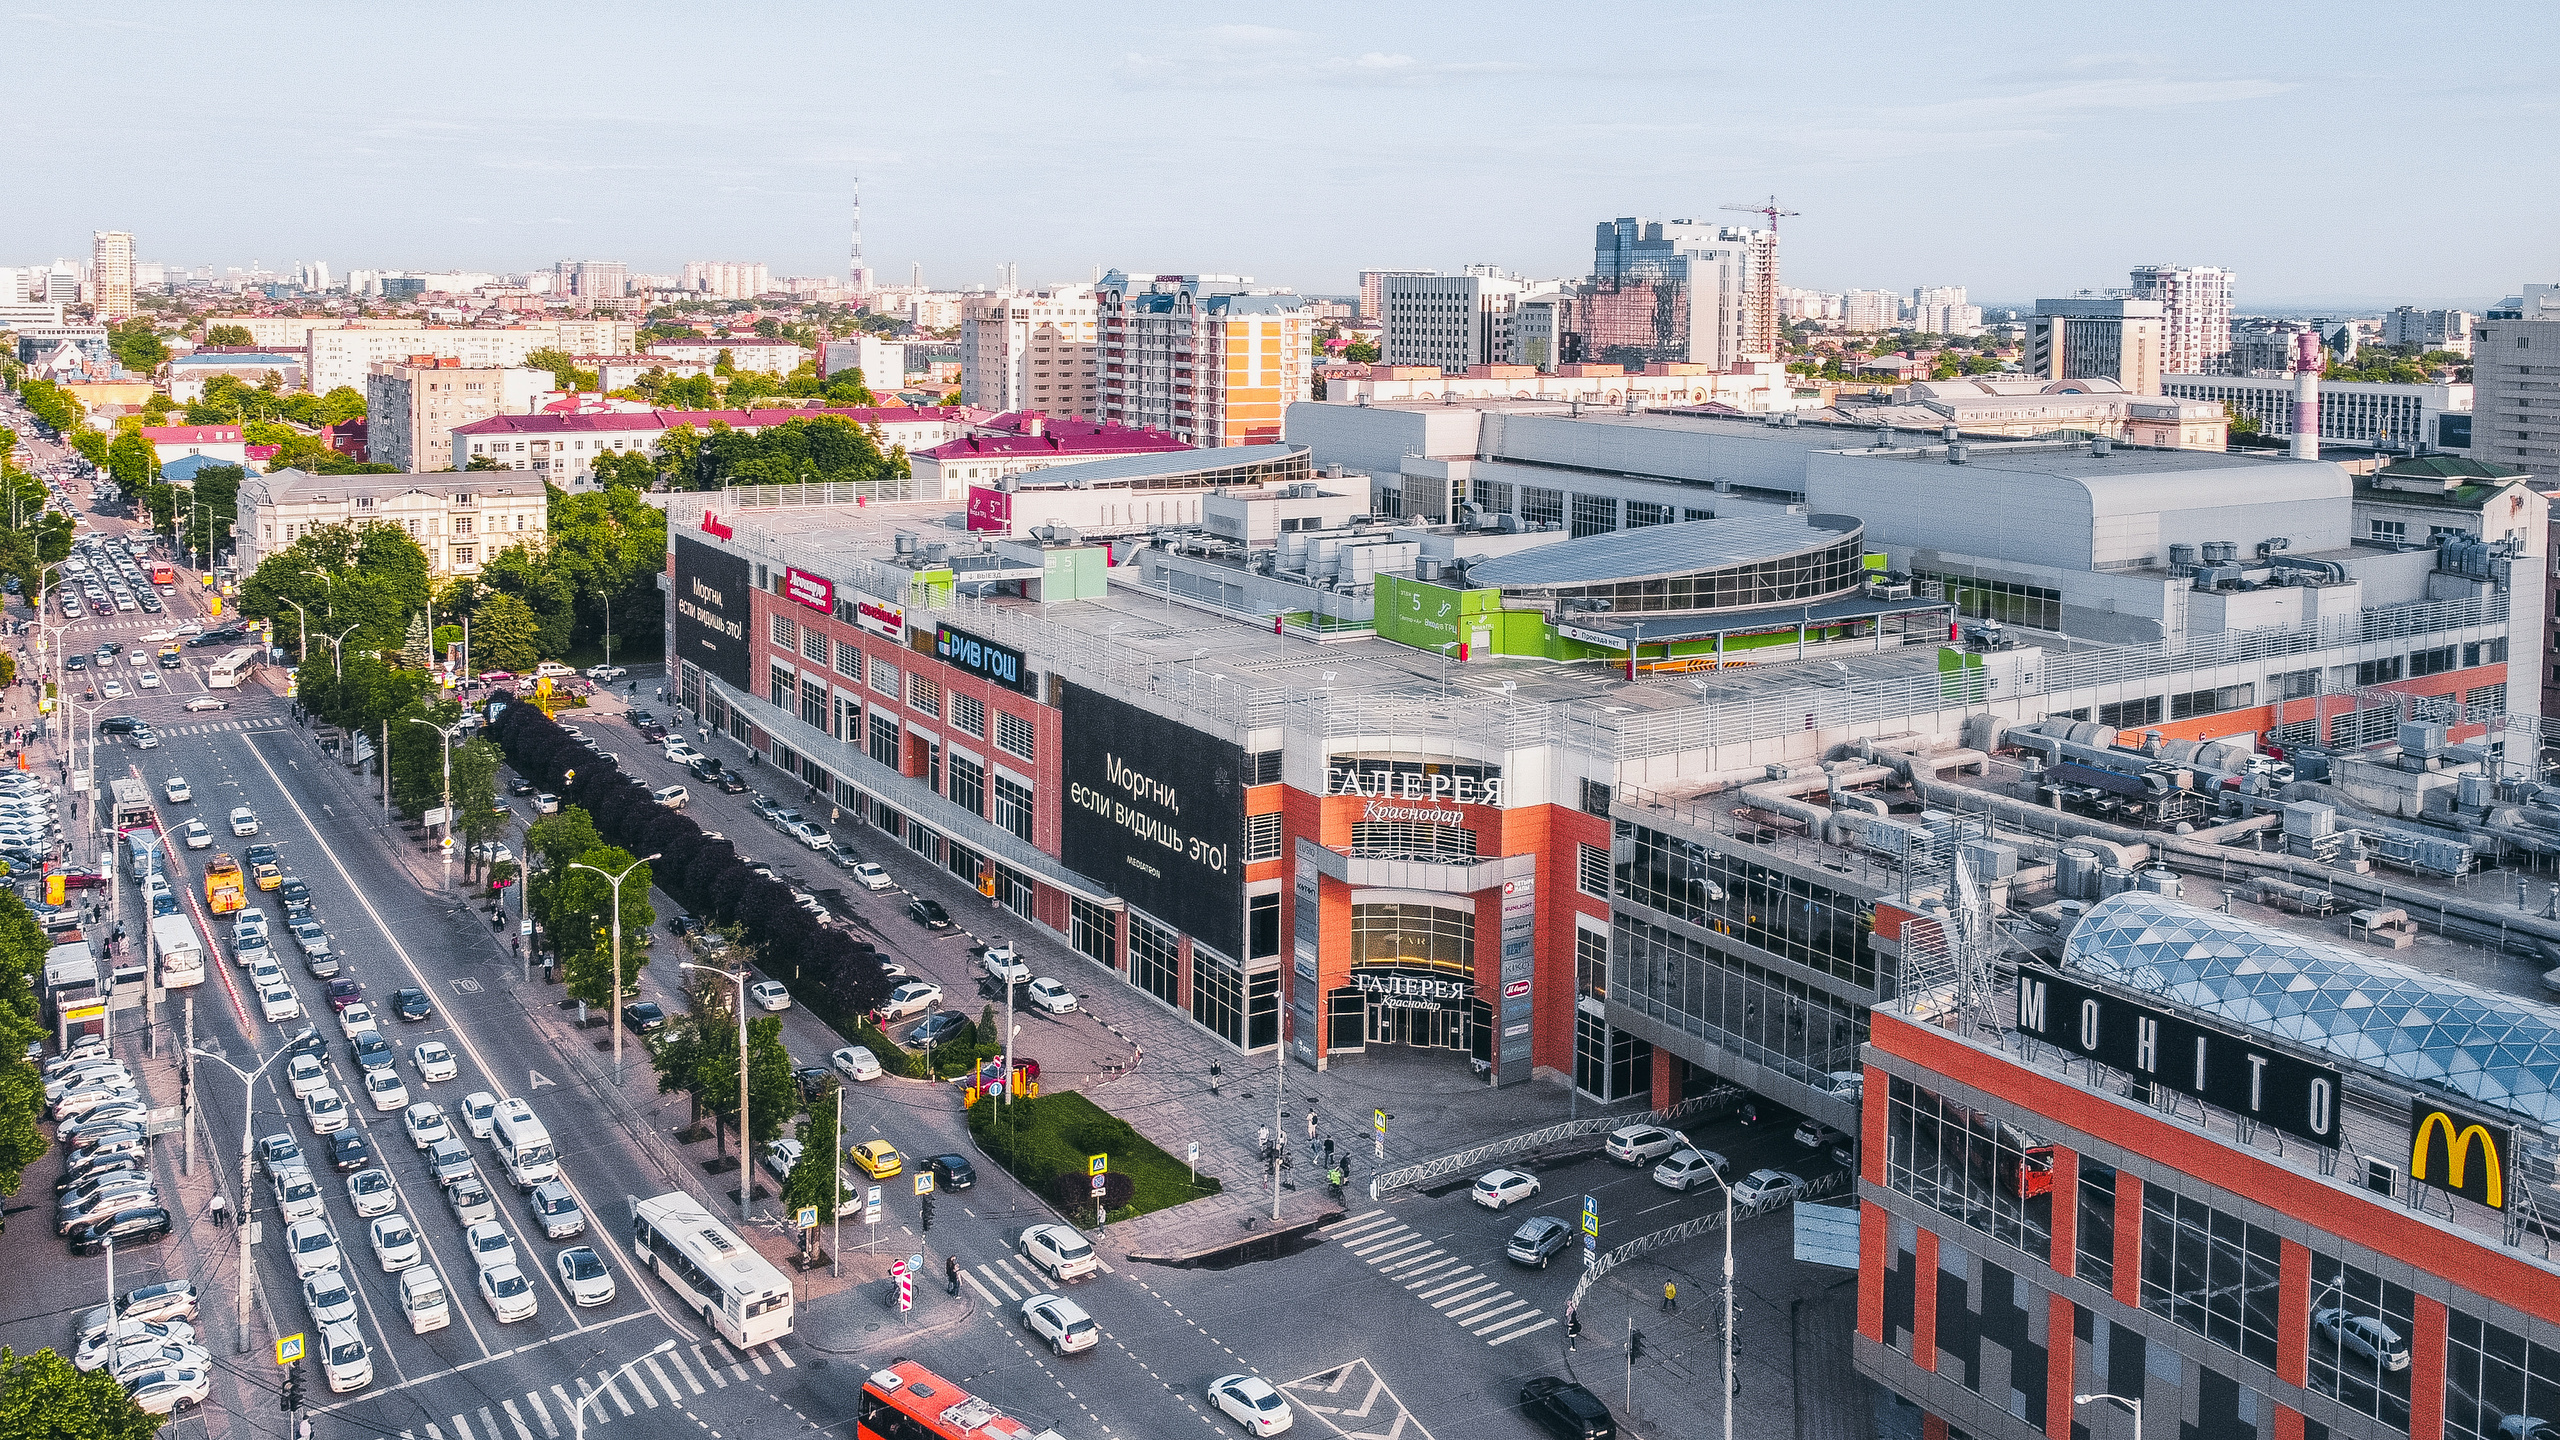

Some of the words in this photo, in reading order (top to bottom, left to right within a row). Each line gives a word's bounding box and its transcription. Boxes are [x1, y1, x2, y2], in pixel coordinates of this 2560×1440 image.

[977, 572, 1002, 580] ВЫЕЗД
[693, 576, 723, 609] Моргни,
[1412, 593, 1421, 611] 5
[678, 598, 696, 619] если
[697, 609, 725, 633] видишь
[726, 620, 742, 641] это!
[951, 633, 981, 668] РИВ
[984, 646, 1017, 682] ГОШ
[1106, 752, 1180, 816] Моргни,
[1320, 766, 1505, 808] ГАЛЕРЕЯ
[1363, 800, 1464, 827] Краснодар
[1070, 781, 1110, 819] если
[1115, 802, 1184, 853] видишь
[1188, 836, 1227, 875] это!
[1126, 855, 1161, 879] MEDIATRON
[1504, 902, 1532, 912] SUNLIGHT
[1505, 961, 1530, 974] KIKO
[1357, 973, 1465, 1000] ГАЛЕРЕЯ
[1381, 994, 1441, 1012] Краснодар
[2020, 976, 2333, 1136] MOHITO
